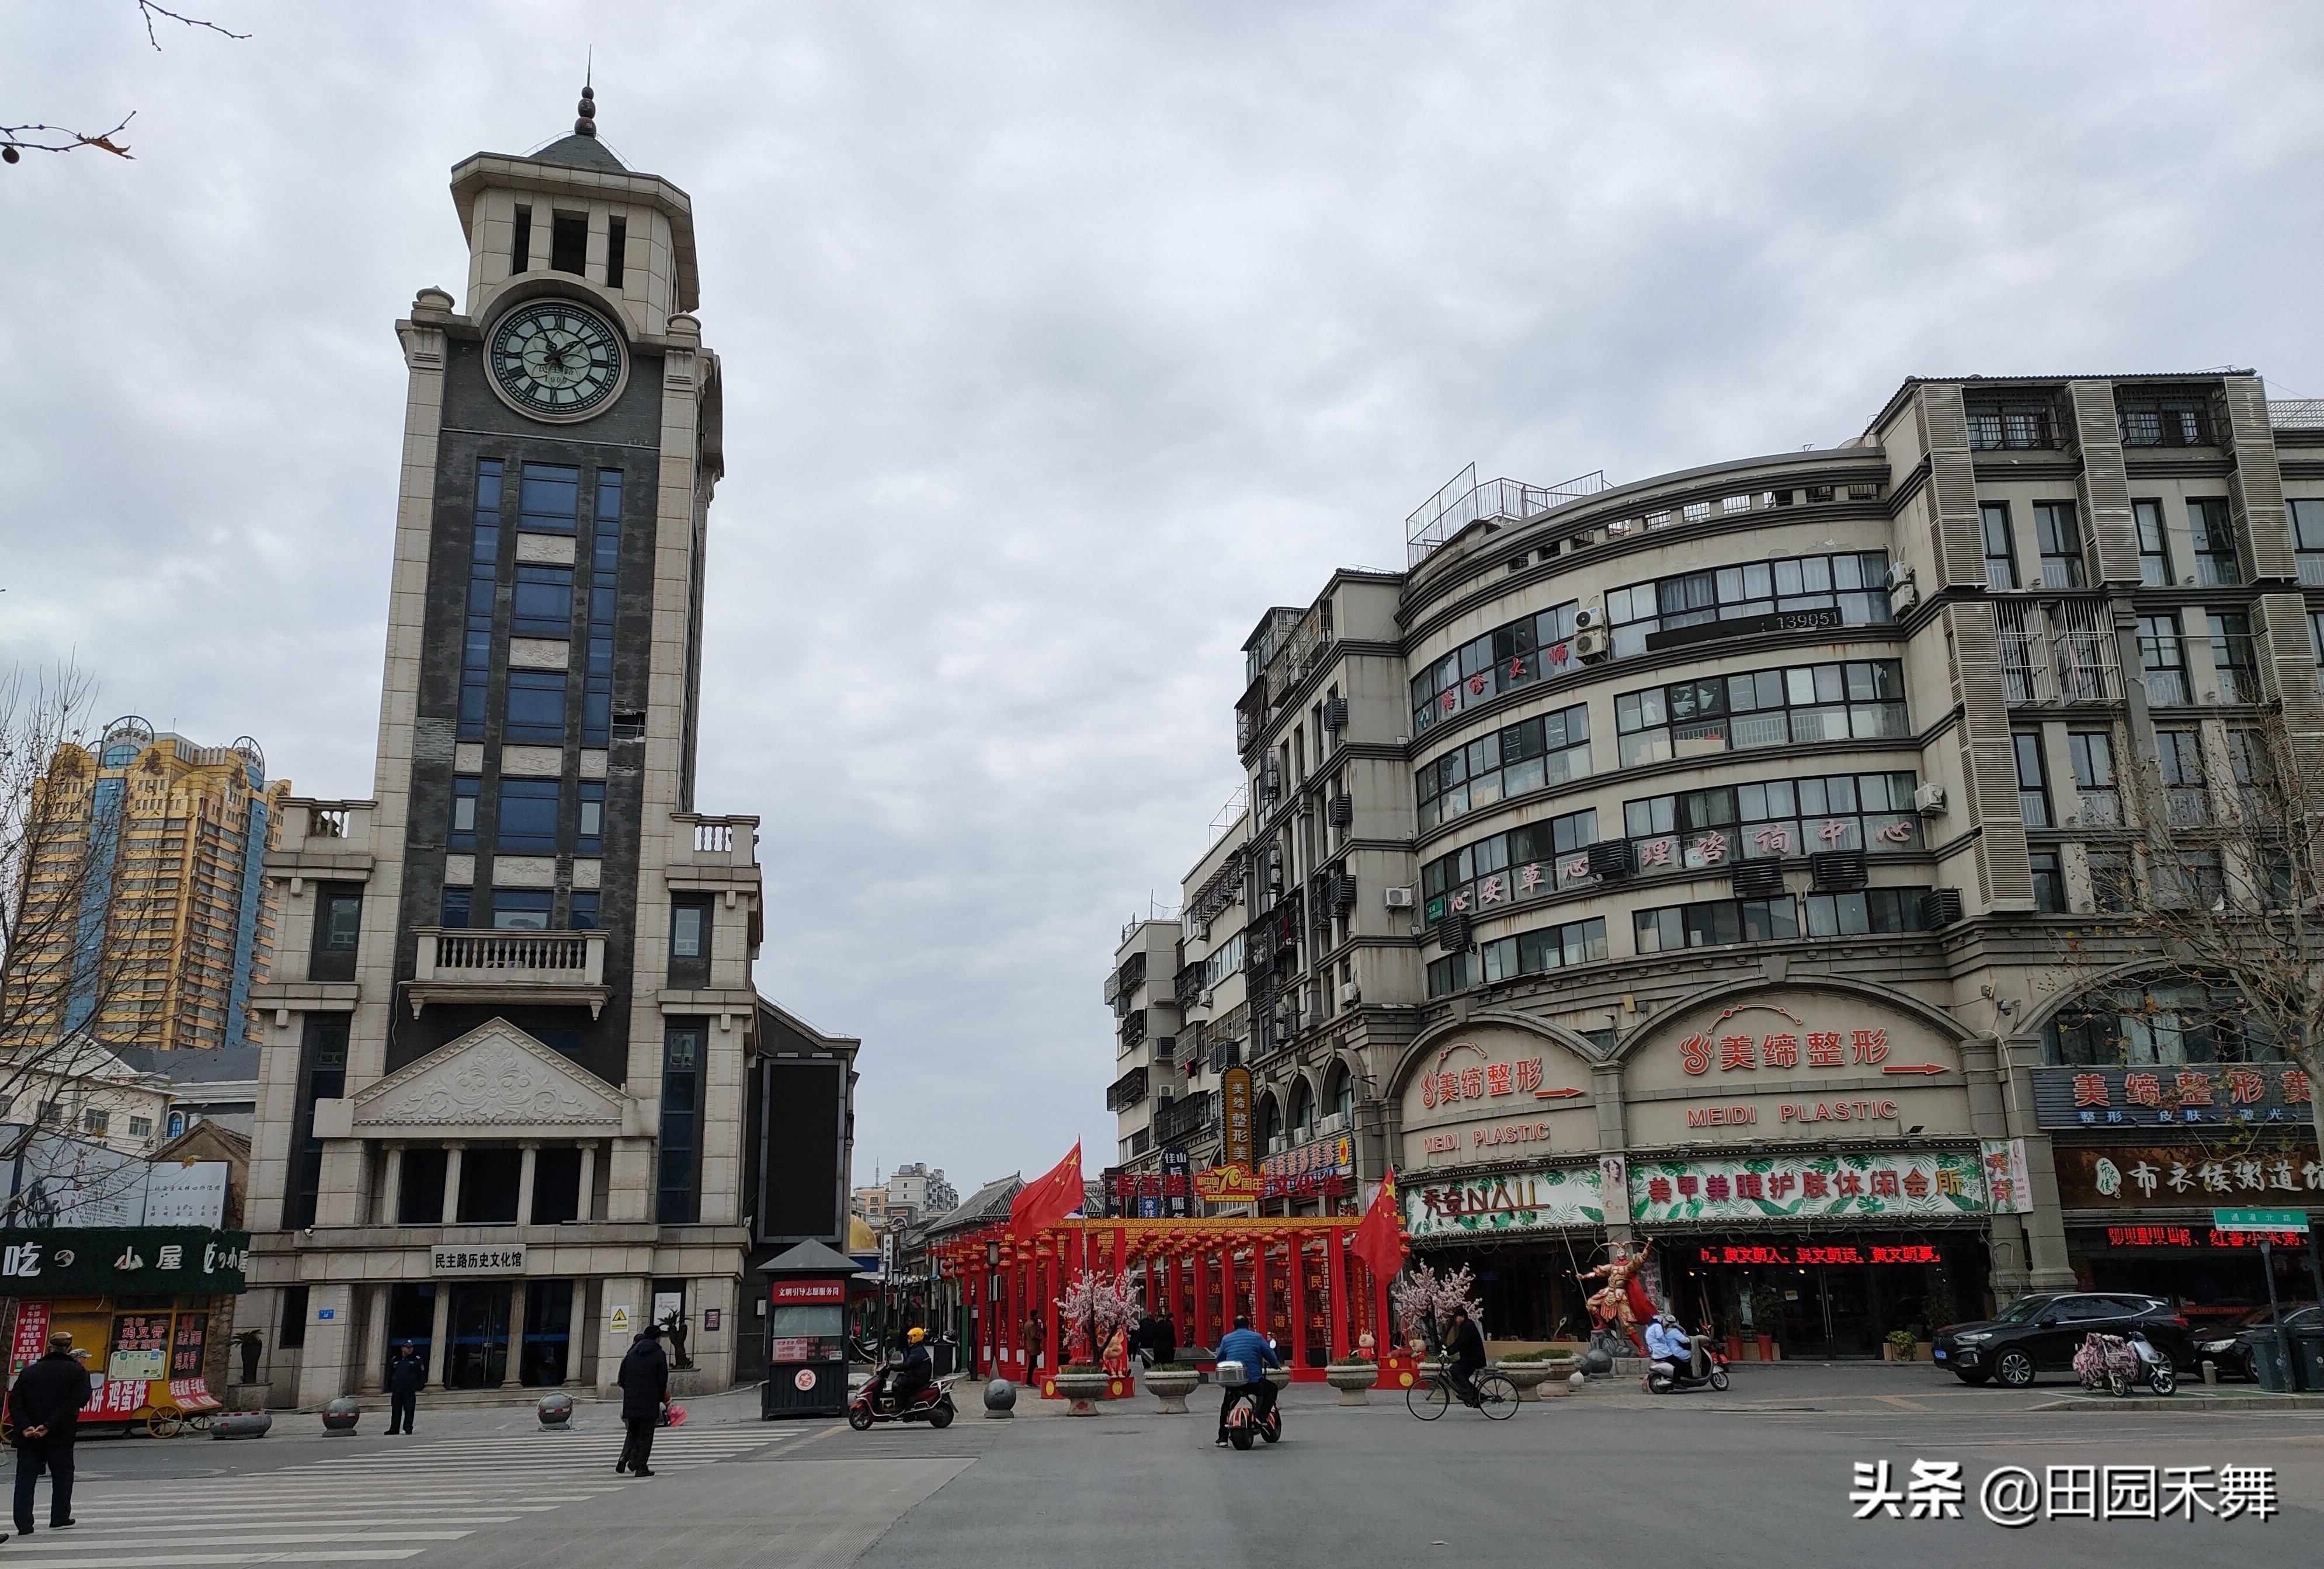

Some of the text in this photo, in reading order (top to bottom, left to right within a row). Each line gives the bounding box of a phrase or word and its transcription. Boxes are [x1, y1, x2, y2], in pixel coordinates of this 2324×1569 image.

[1719, 1028, 1891, 1071] 美缔整形
[1439, 1057, 1544, 1104] 美缔整形
[1687, 1100, 1898, 1127] MEIDI PLASTIC
[1424, 1122, 1550, 1153] MEIDI PLASTIC
[1241, 1178, 1265, 1191] 周年
[1647, 1168, 1963, 1204] 美甲美睫护肤休闲会所
[1986, 1153, 2014, 1202] 秀奇
[2, 1241, 185, 1278] 吃の小屋
[435, 1251, 523, 1269] 民主路历史文化馆
[778, 1287, 840, 1297] 文明引导志愿服务岗
[121, 1326, 165, 1339] 鸡叉骨
[107, 1380, 147, 1412] 鸡蛋饼
